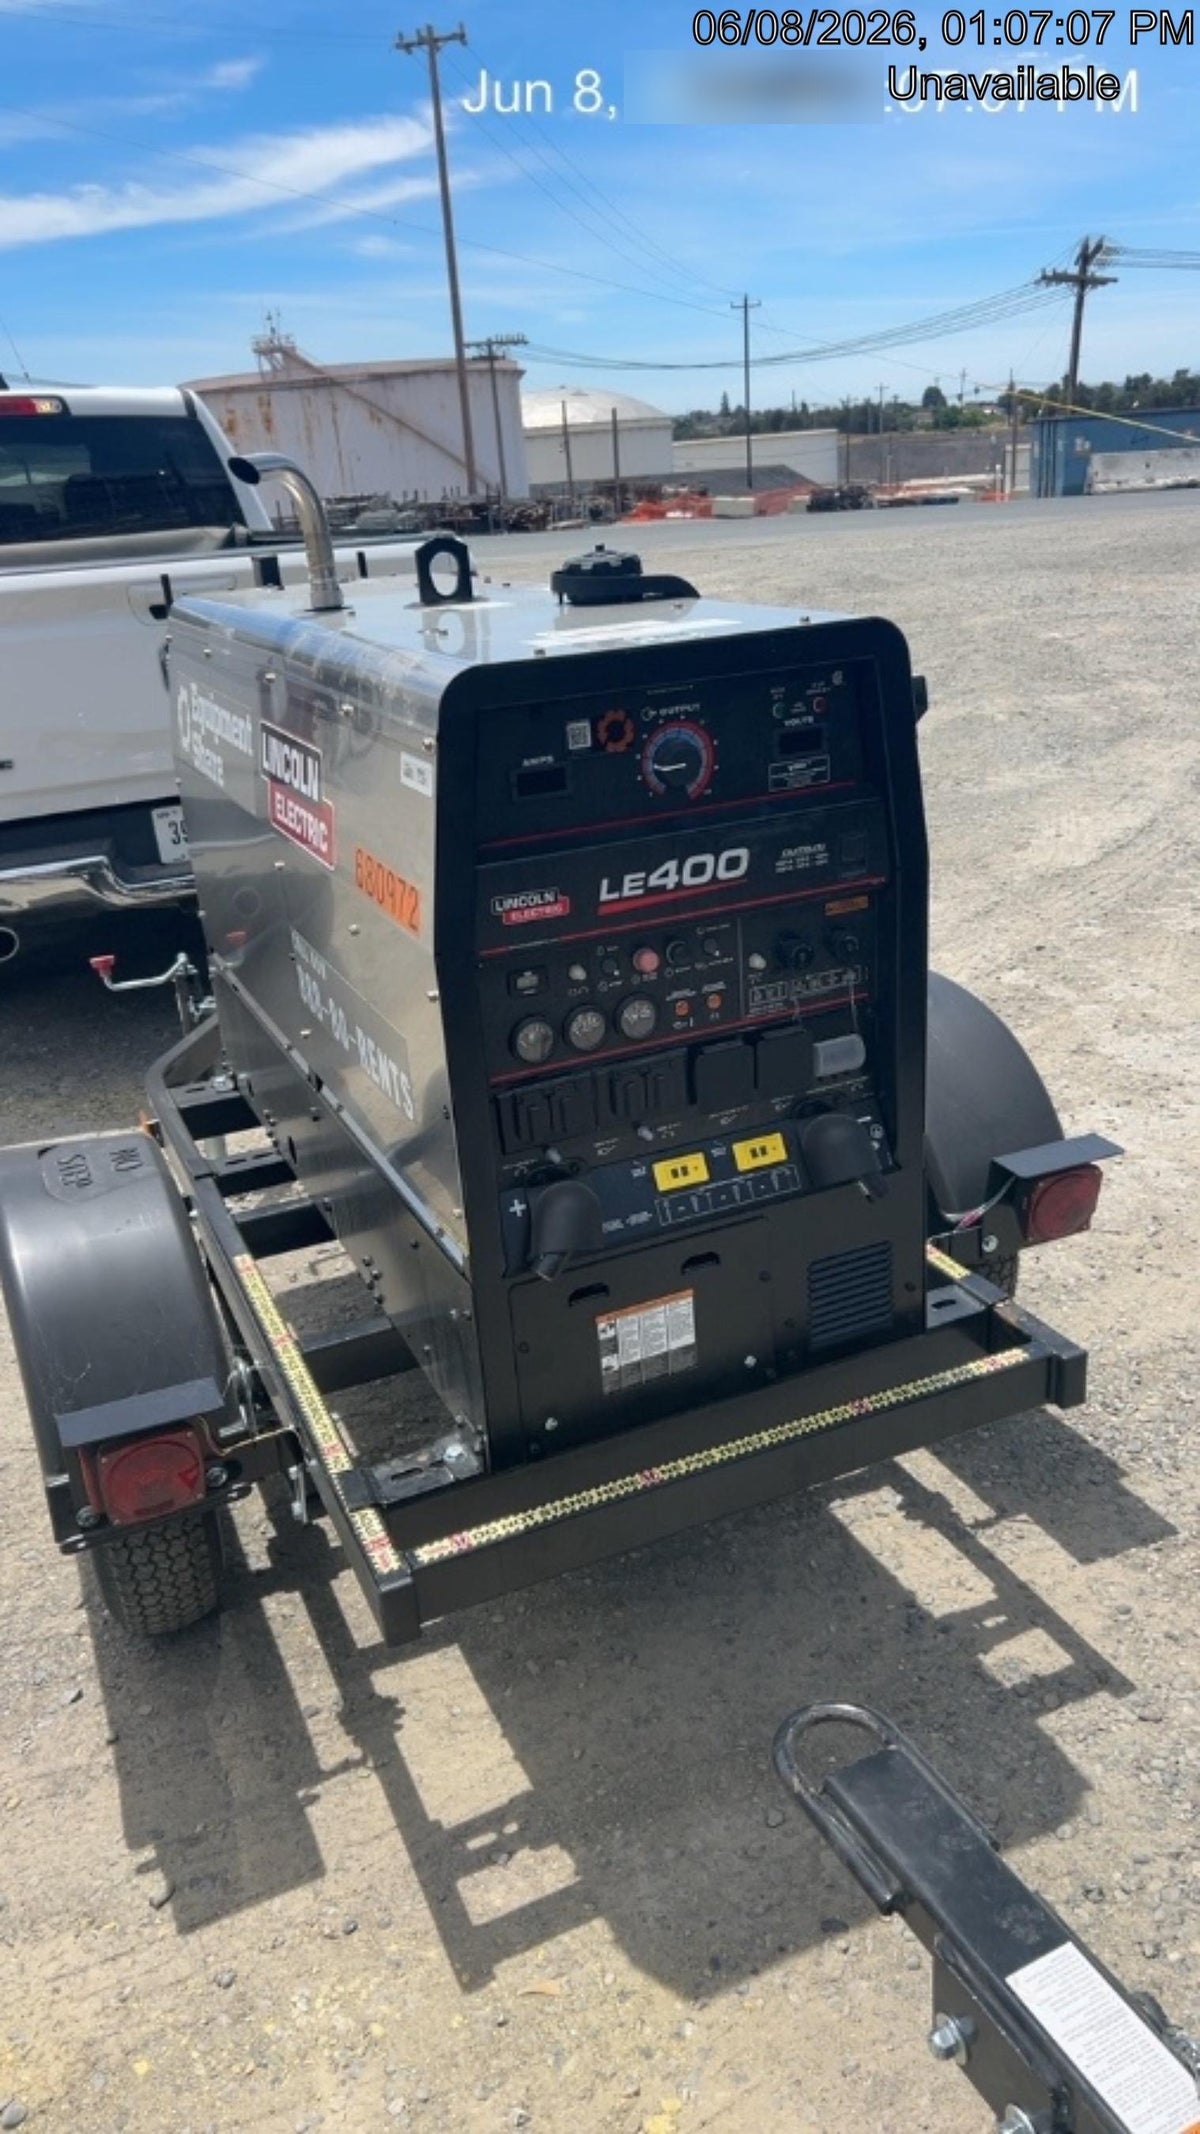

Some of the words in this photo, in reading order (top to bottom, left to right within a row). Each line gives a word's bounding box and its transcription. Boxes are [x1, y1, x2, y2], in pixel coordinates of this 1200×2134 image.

[262, 728, 320, 803] LINCOLN
[274, 790, 329, 854] ELECTRIC
[355, 848, 419, 932] 680972
[494, 889, 556, 912] LINCOLN
[598, 846, 750, 904] LE400
[509, 903, 564, 923] ELECTRIC
